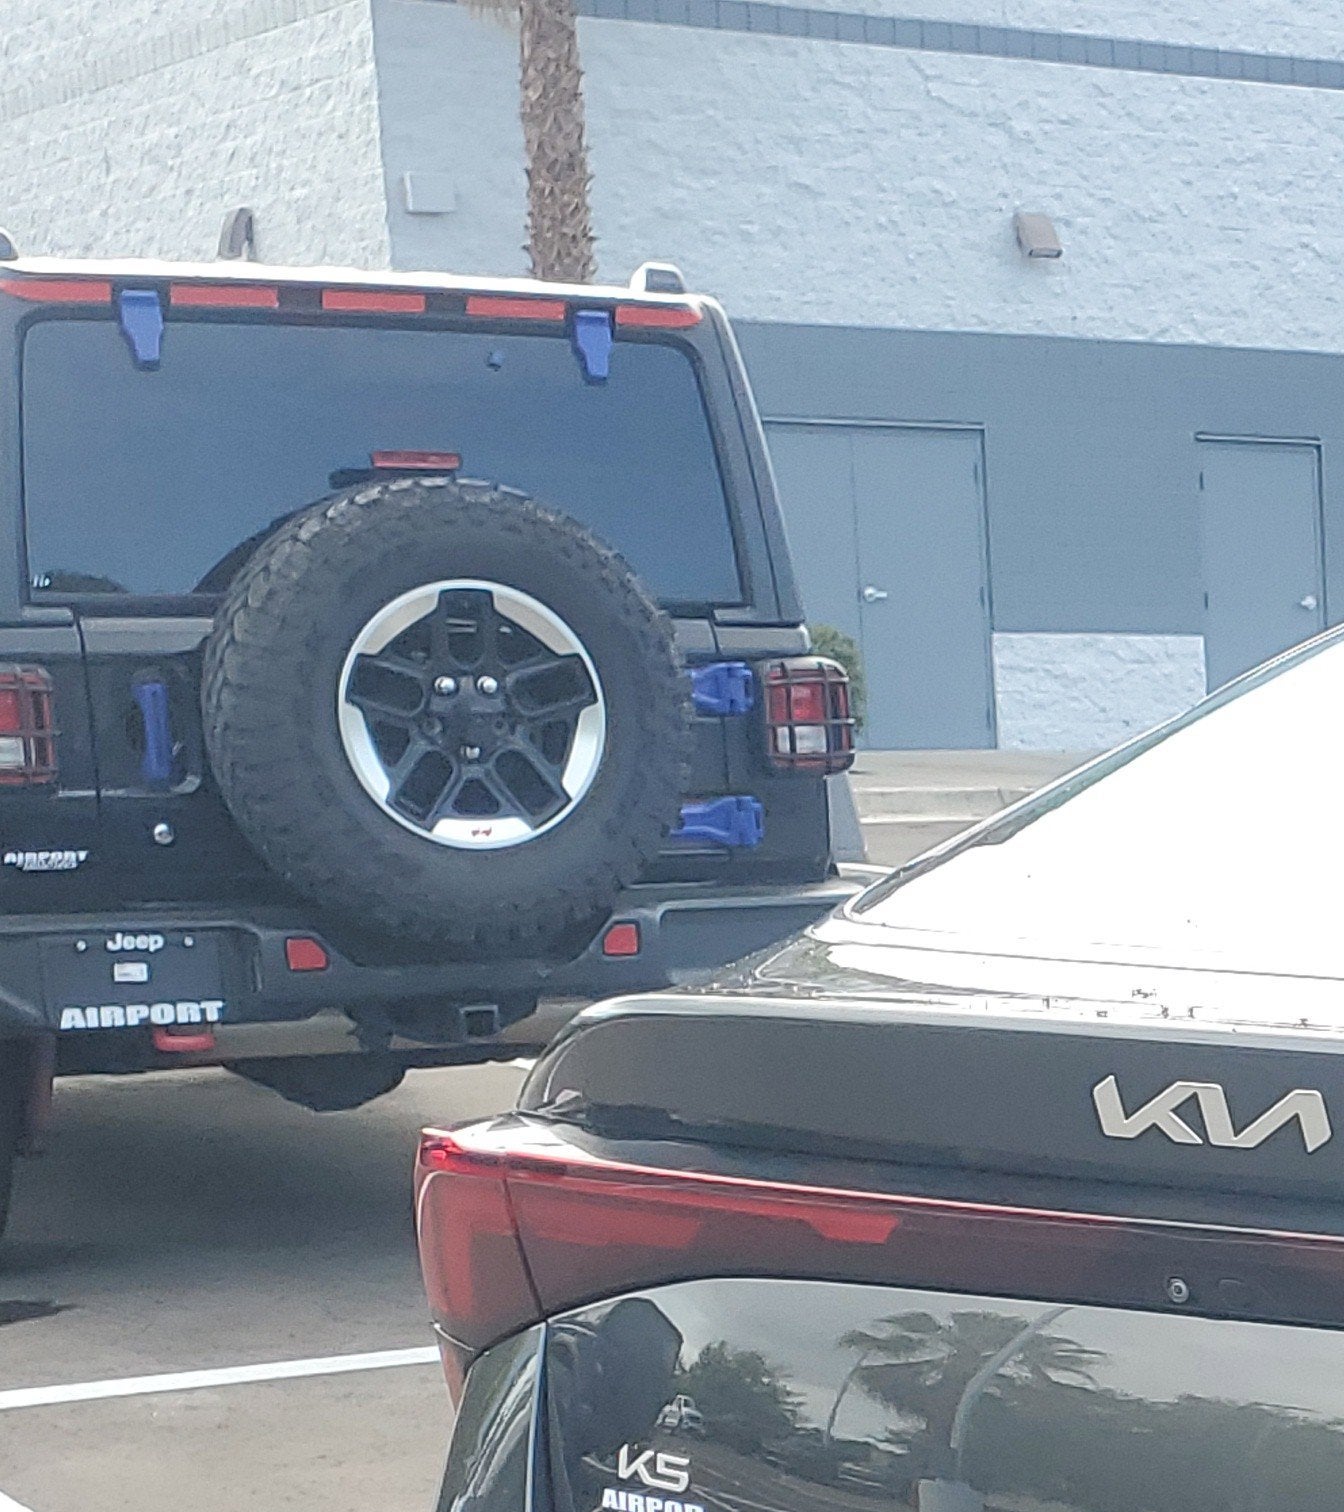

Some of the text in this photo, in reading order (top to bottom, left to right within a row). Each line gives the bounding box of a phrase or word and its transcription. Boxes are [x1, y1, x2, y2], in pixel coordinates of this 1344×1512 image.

[106, 932, 165, 952] Jeep
[60, 1000, 224, 1030] AIRPORT
[618, 1443, 690, 1493] K5
